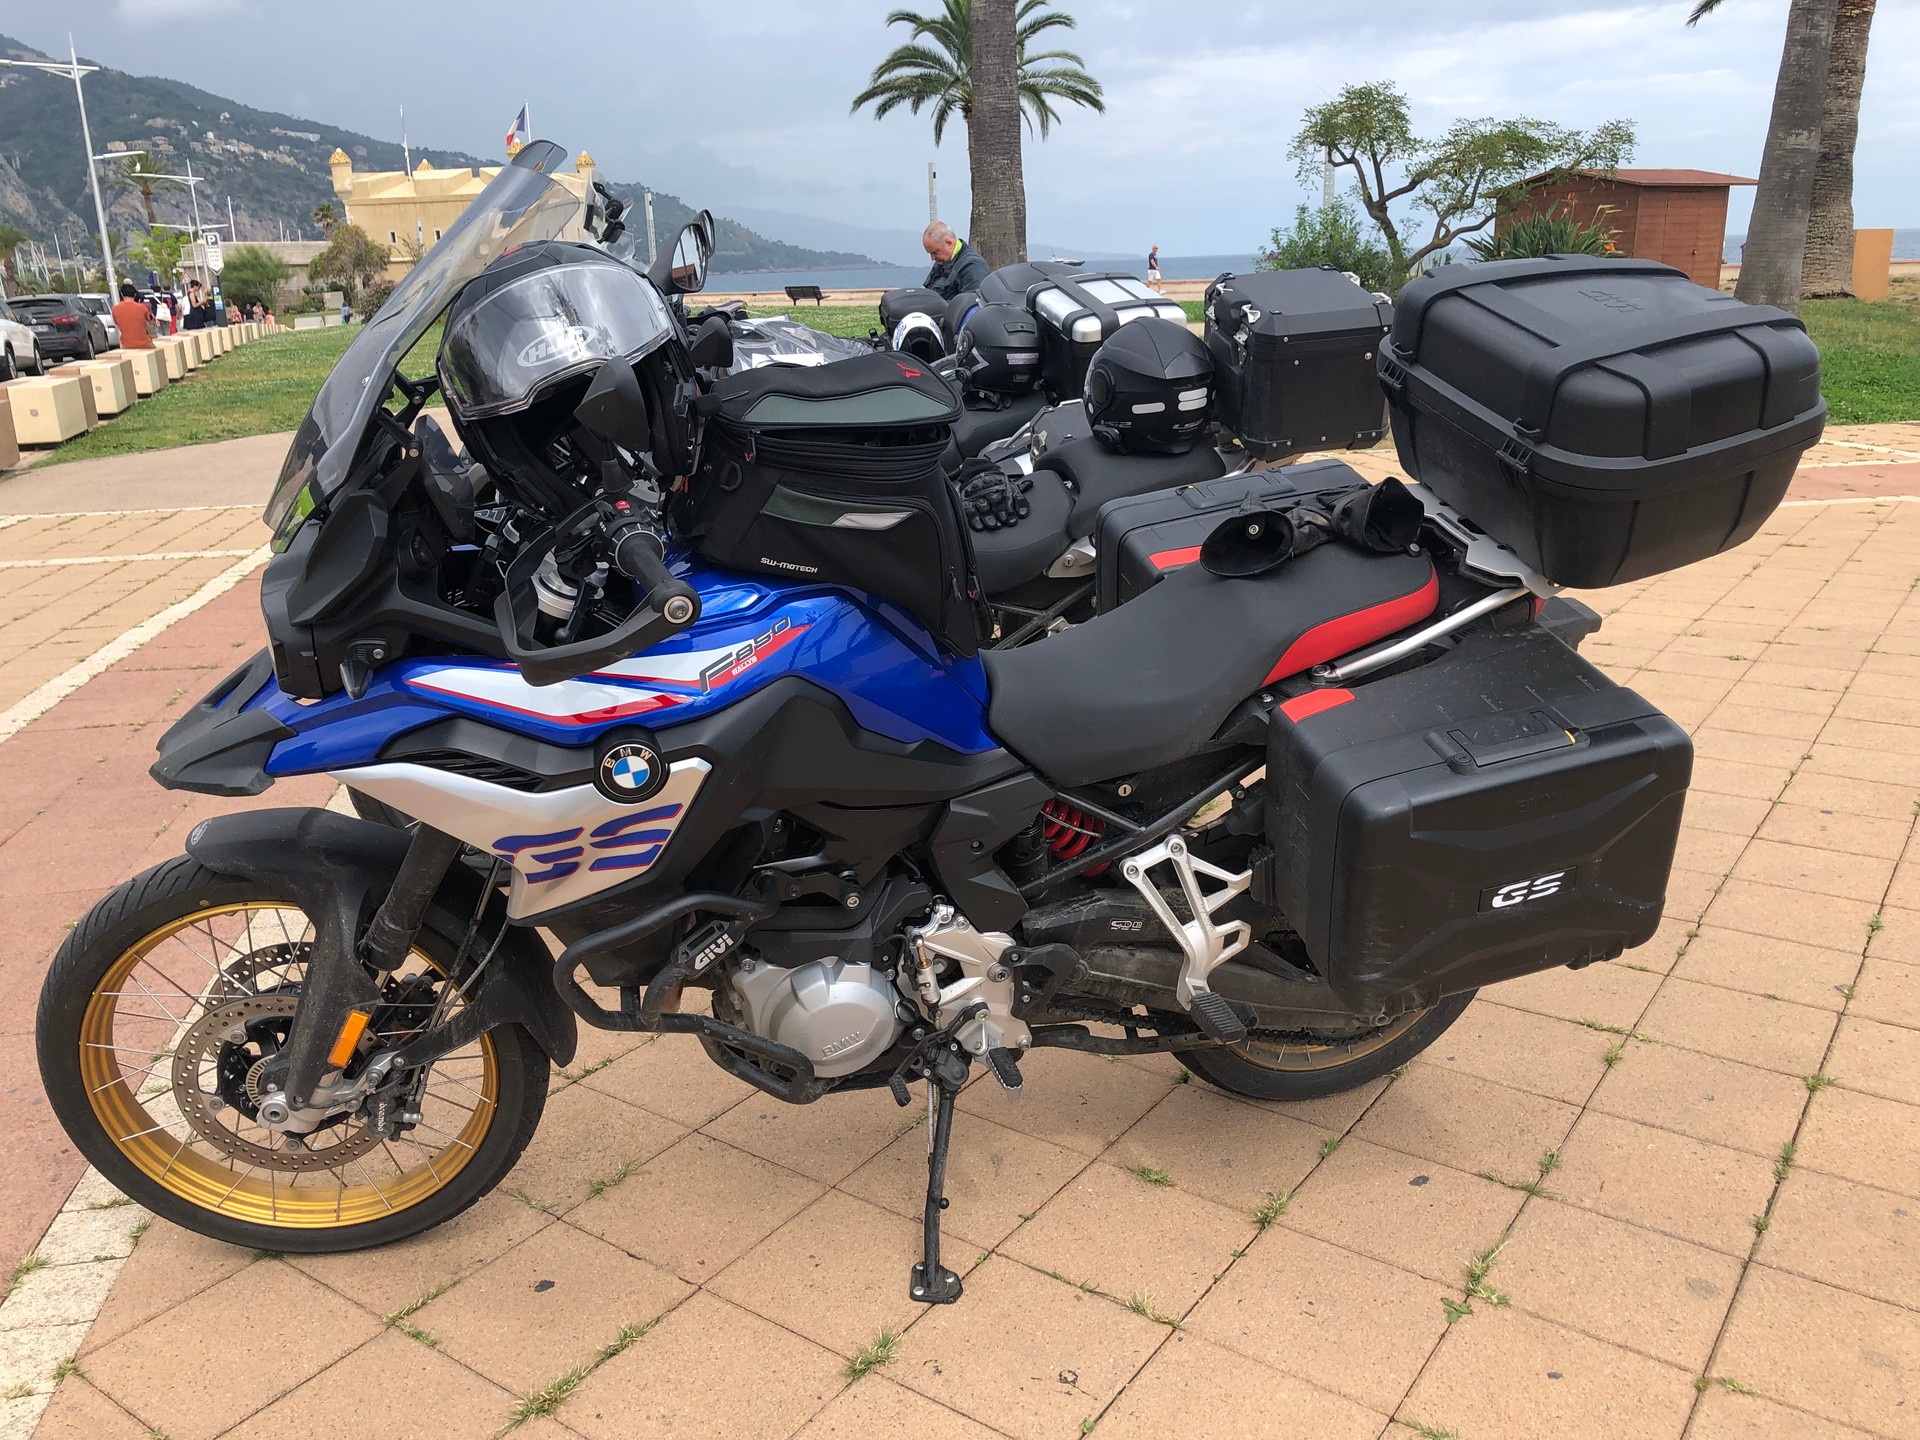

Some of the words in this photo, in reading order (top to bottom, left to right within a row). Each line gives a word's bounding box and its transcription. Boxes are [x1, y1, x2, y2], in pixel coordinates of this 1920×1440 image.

[207, 235, 216, 246] P
[213, 287, 220, 295] P
[760, 557, 818, 574] SW-MOTECH
[604, 747, 652, 769] BMW
[491, 803, 684, 885] GS
[1492, 872, 1565, 908] GS
[695, 933, 734, 970] GIVI
[822, 1030, 860, 1057] BMW
[378, 1102, 387, 1132] brembo
